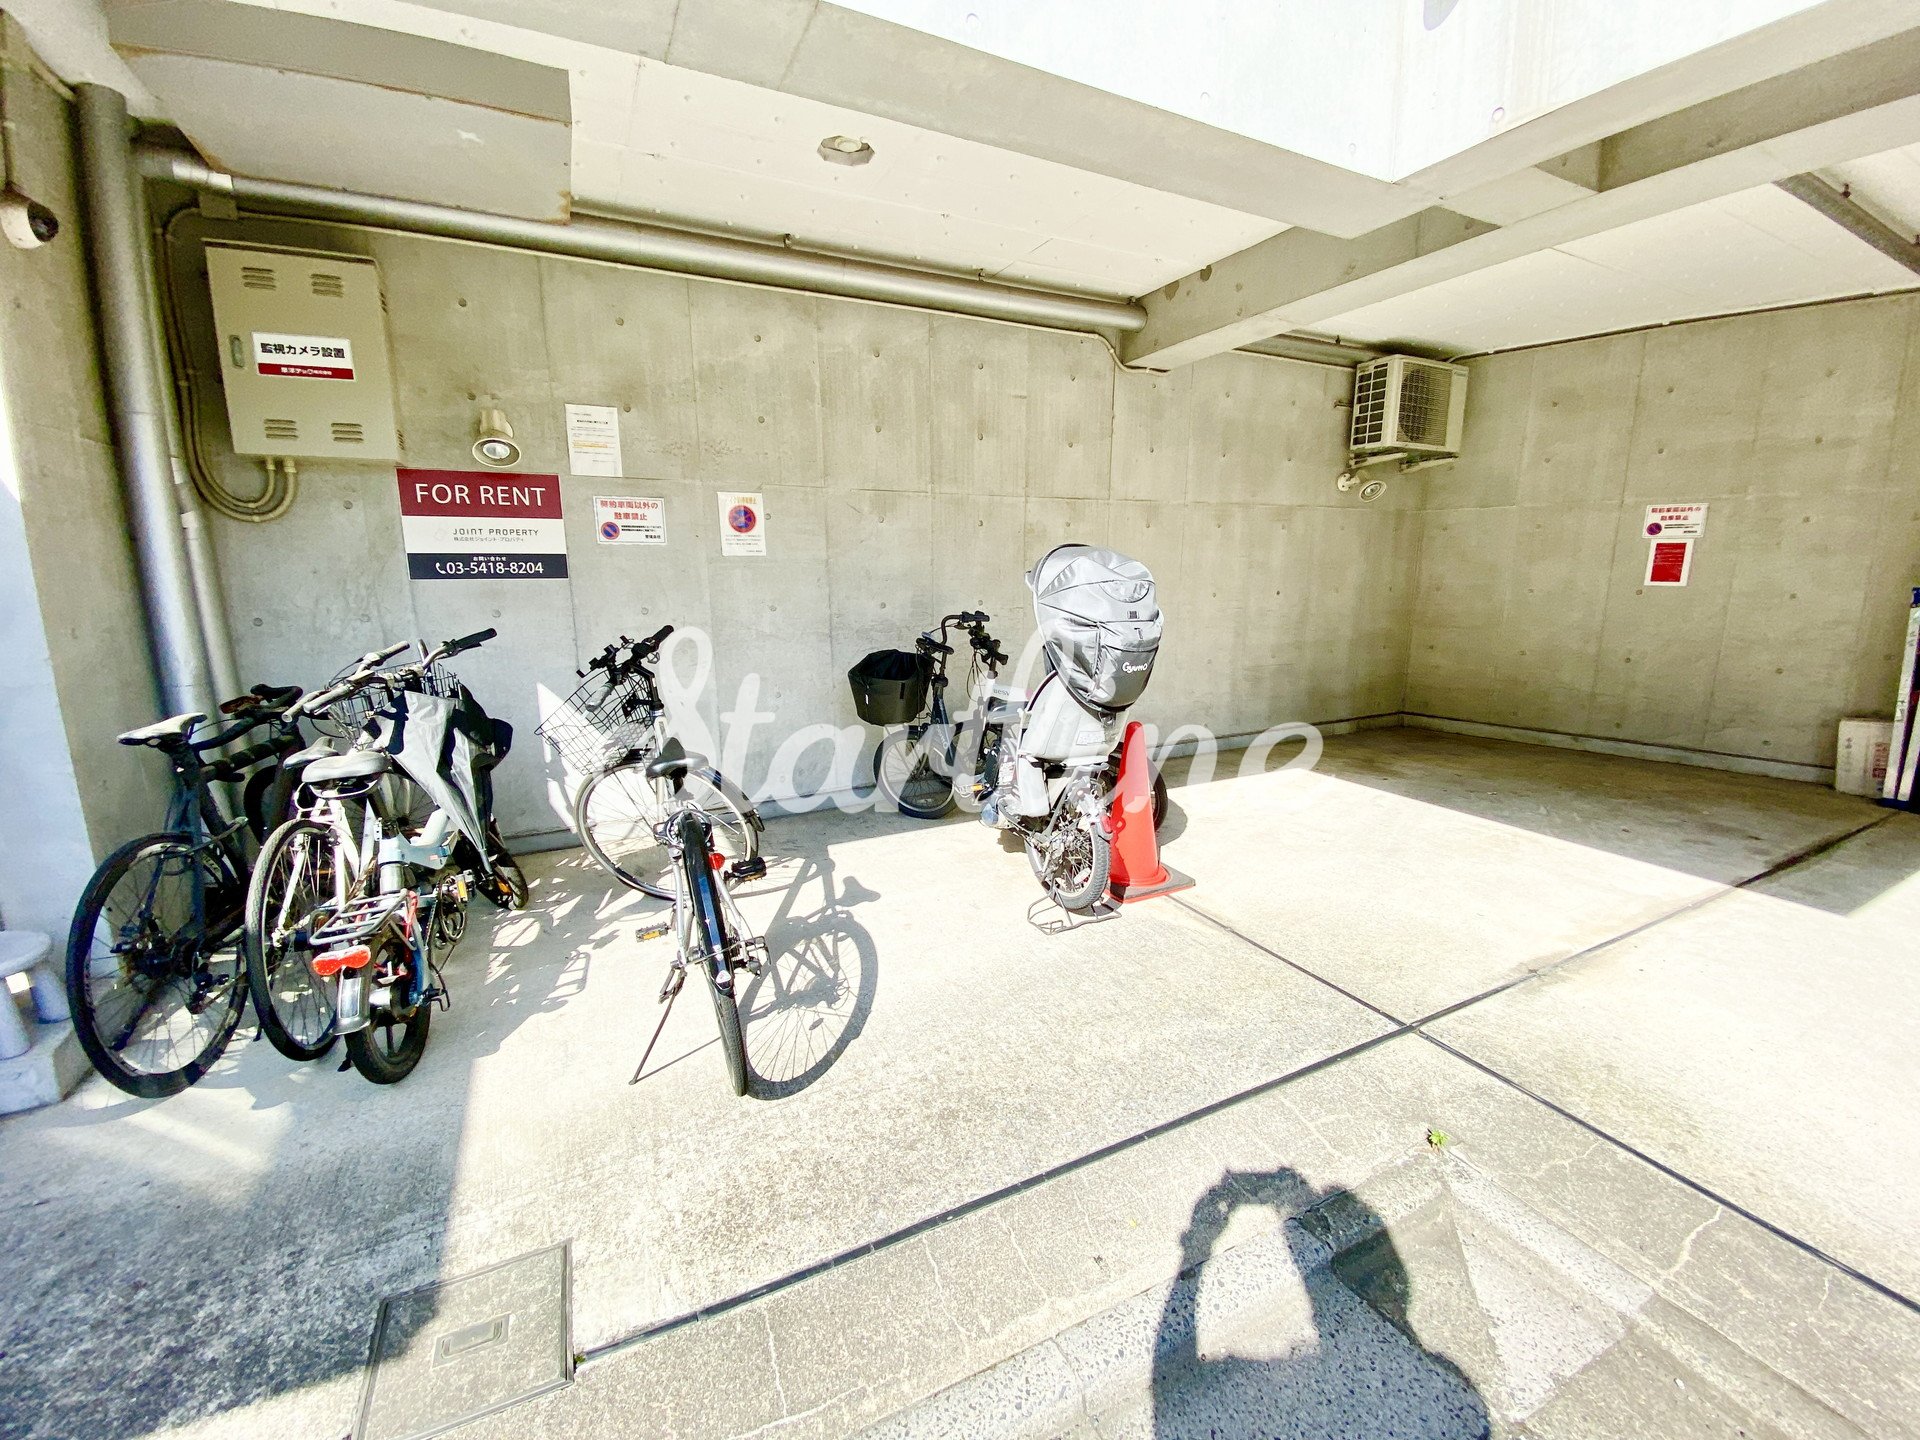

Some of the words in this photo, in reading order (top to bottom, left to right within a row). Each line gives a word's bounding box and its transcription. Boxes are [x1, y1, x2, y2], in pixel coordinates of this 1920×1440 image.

[260, 342, 346, 358] 監視カメラ設置
[415, 483, 471, 505] FOR
[480, 485, 546, 506] RENT
[453, 528, 484, 536] JOINT
[489, 528, 540, 537] PROPERTY
[445, 561, 545, 574] 03-5418-8204
